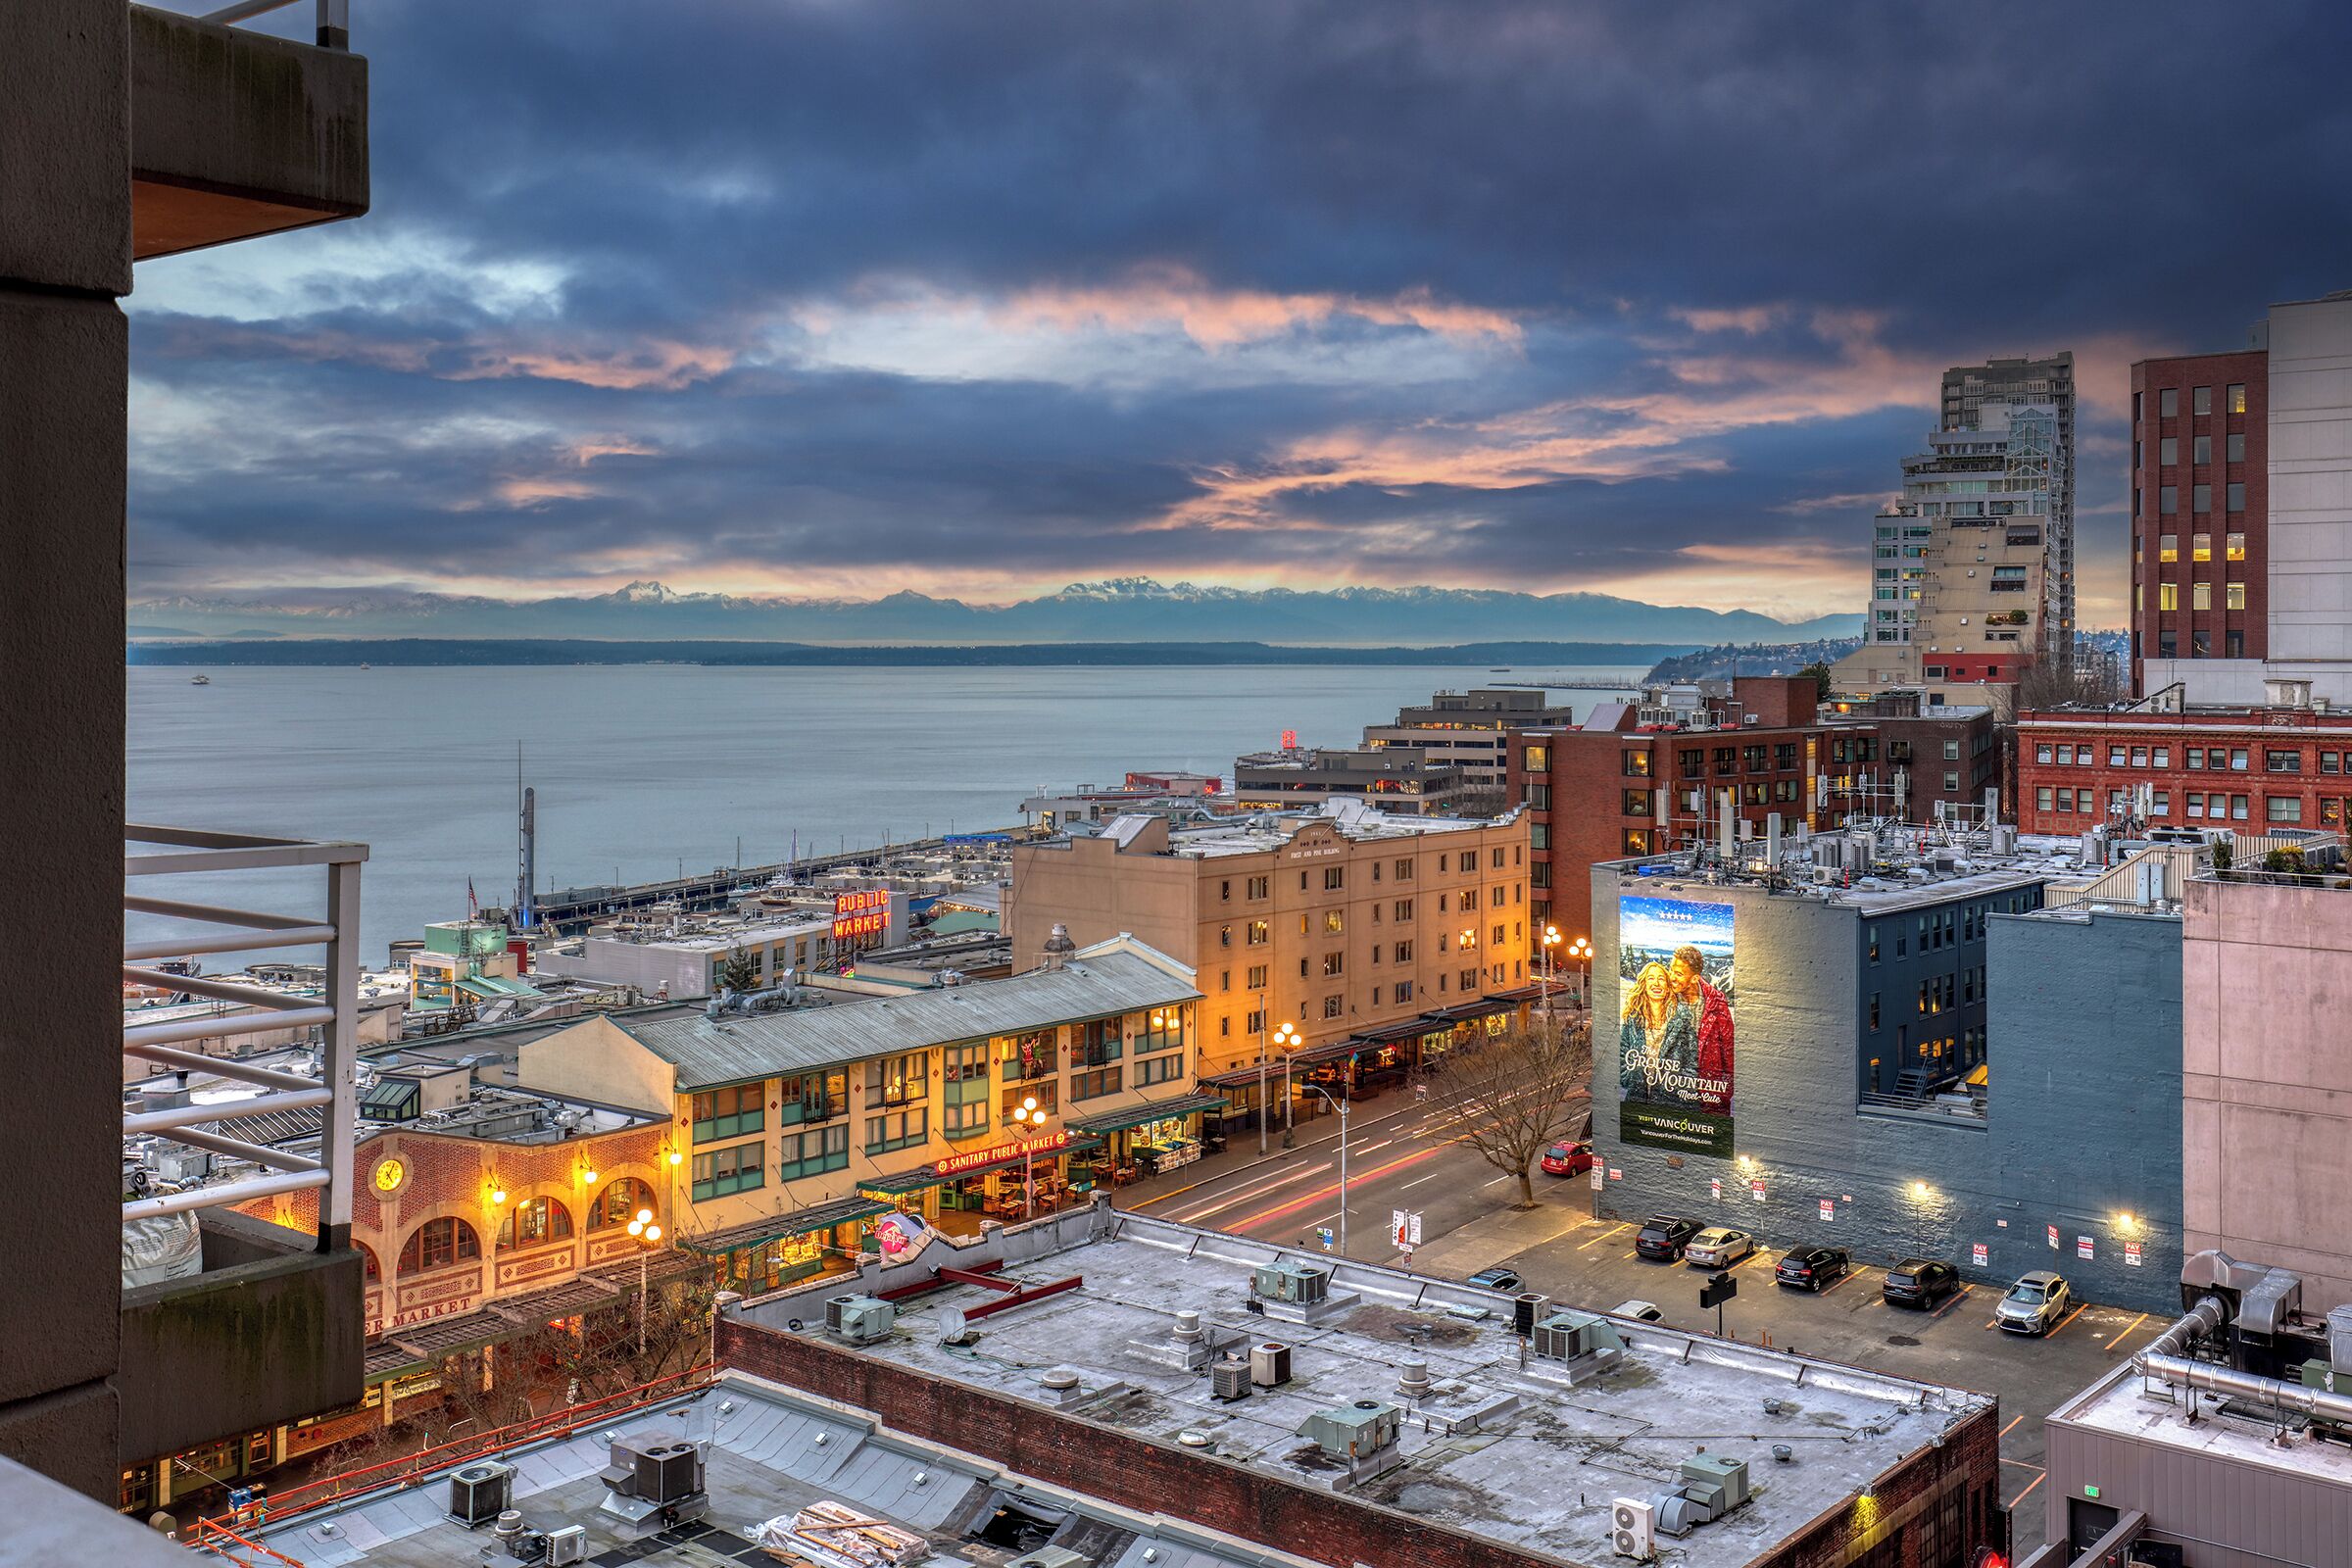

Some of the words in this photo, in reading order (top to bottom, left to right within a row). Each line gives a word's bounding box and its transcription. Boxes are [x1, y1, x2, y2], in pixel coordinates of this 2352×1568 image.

[837, 890, 889, 912] PUBLIC
[834, 912, 890, 937] MARKET
[1625, 1049, 1681, 1071] GROUSE
[1641, 1045, 1657, 1055] The
[1644, 1066, 1729, 1093] MOUNTAIN
[1654, 1118, 1714, 1135] VANCOUVER
[950, 1151, 989, 1170] SANITARY
[992, 1143, 1019, 1159] PUBLIC
[393, 1298, 470, 1328] MARKET
